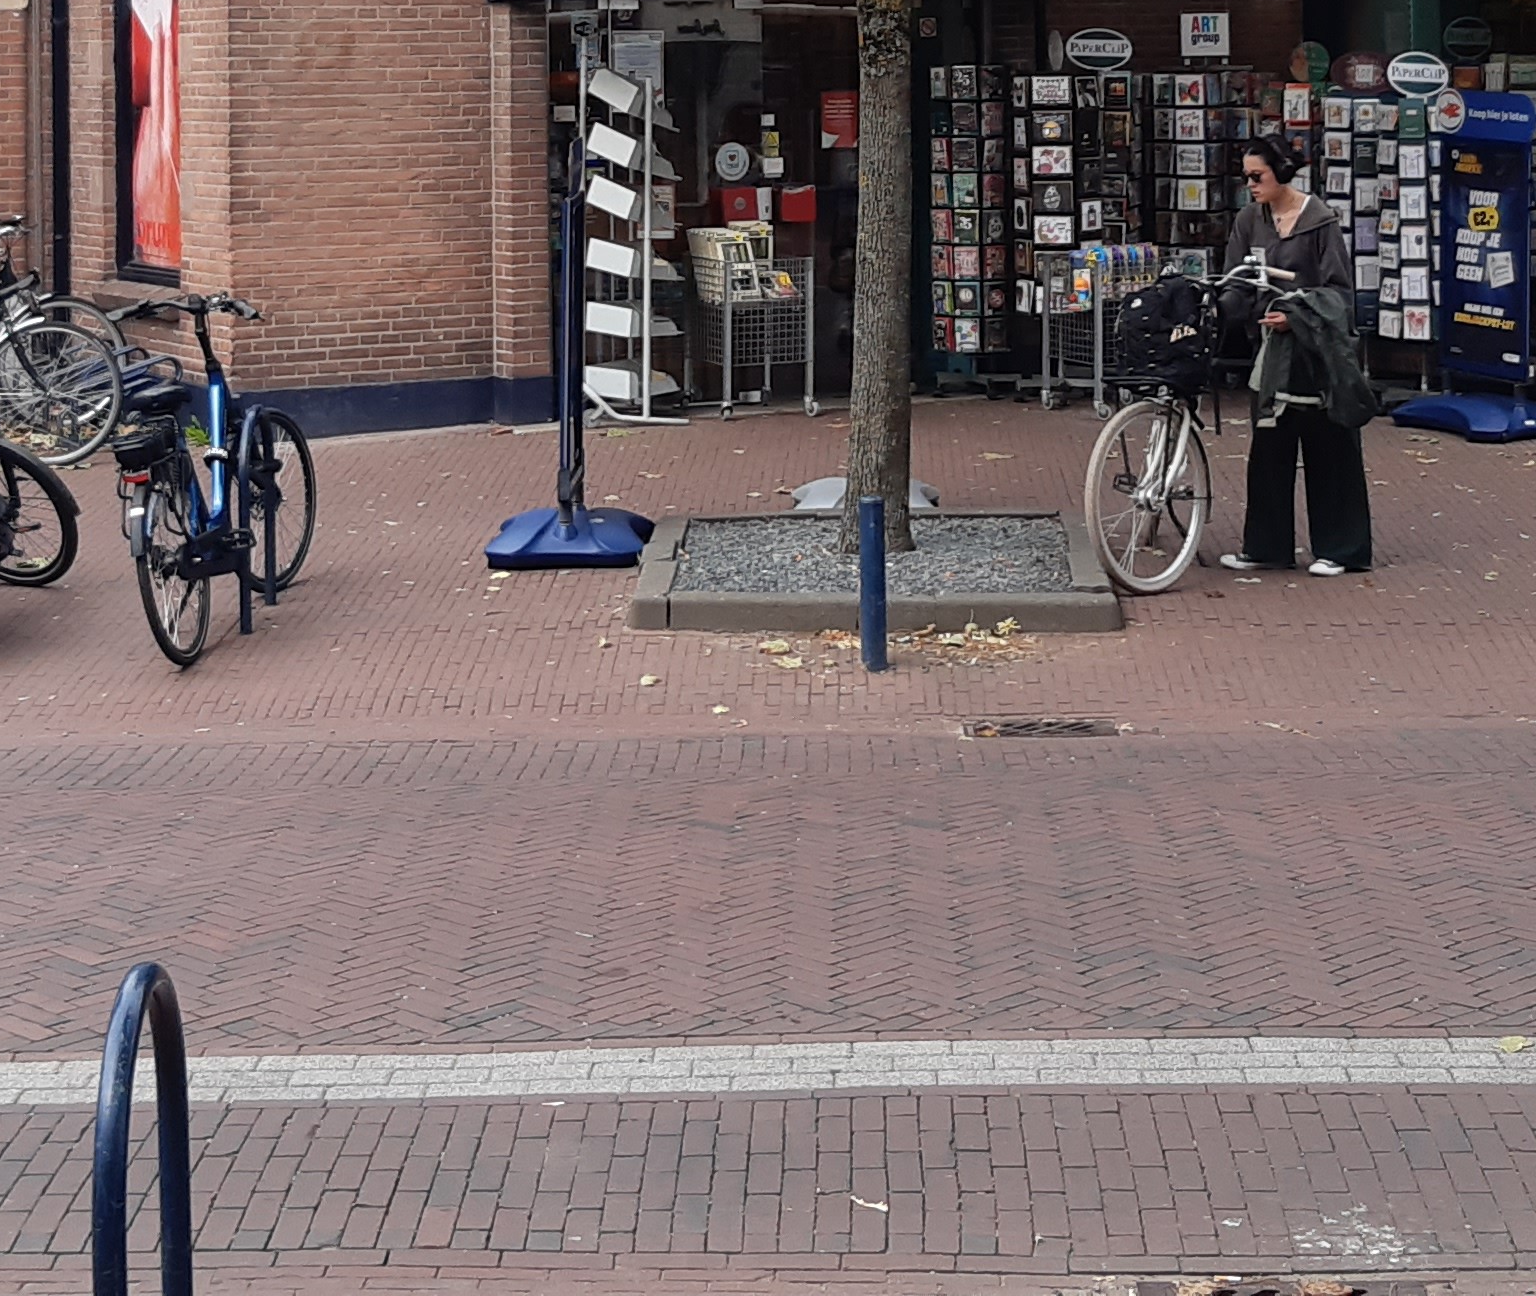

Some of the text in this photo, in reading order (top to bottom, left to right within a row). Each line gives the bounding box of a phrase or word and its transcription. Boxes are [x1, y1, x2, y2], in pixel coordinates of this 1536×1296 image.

[1191, 15, 1220, 33] ART
[1191, 33, 1220, 46] group
[1469, 190, 1499, 206] VOOR
